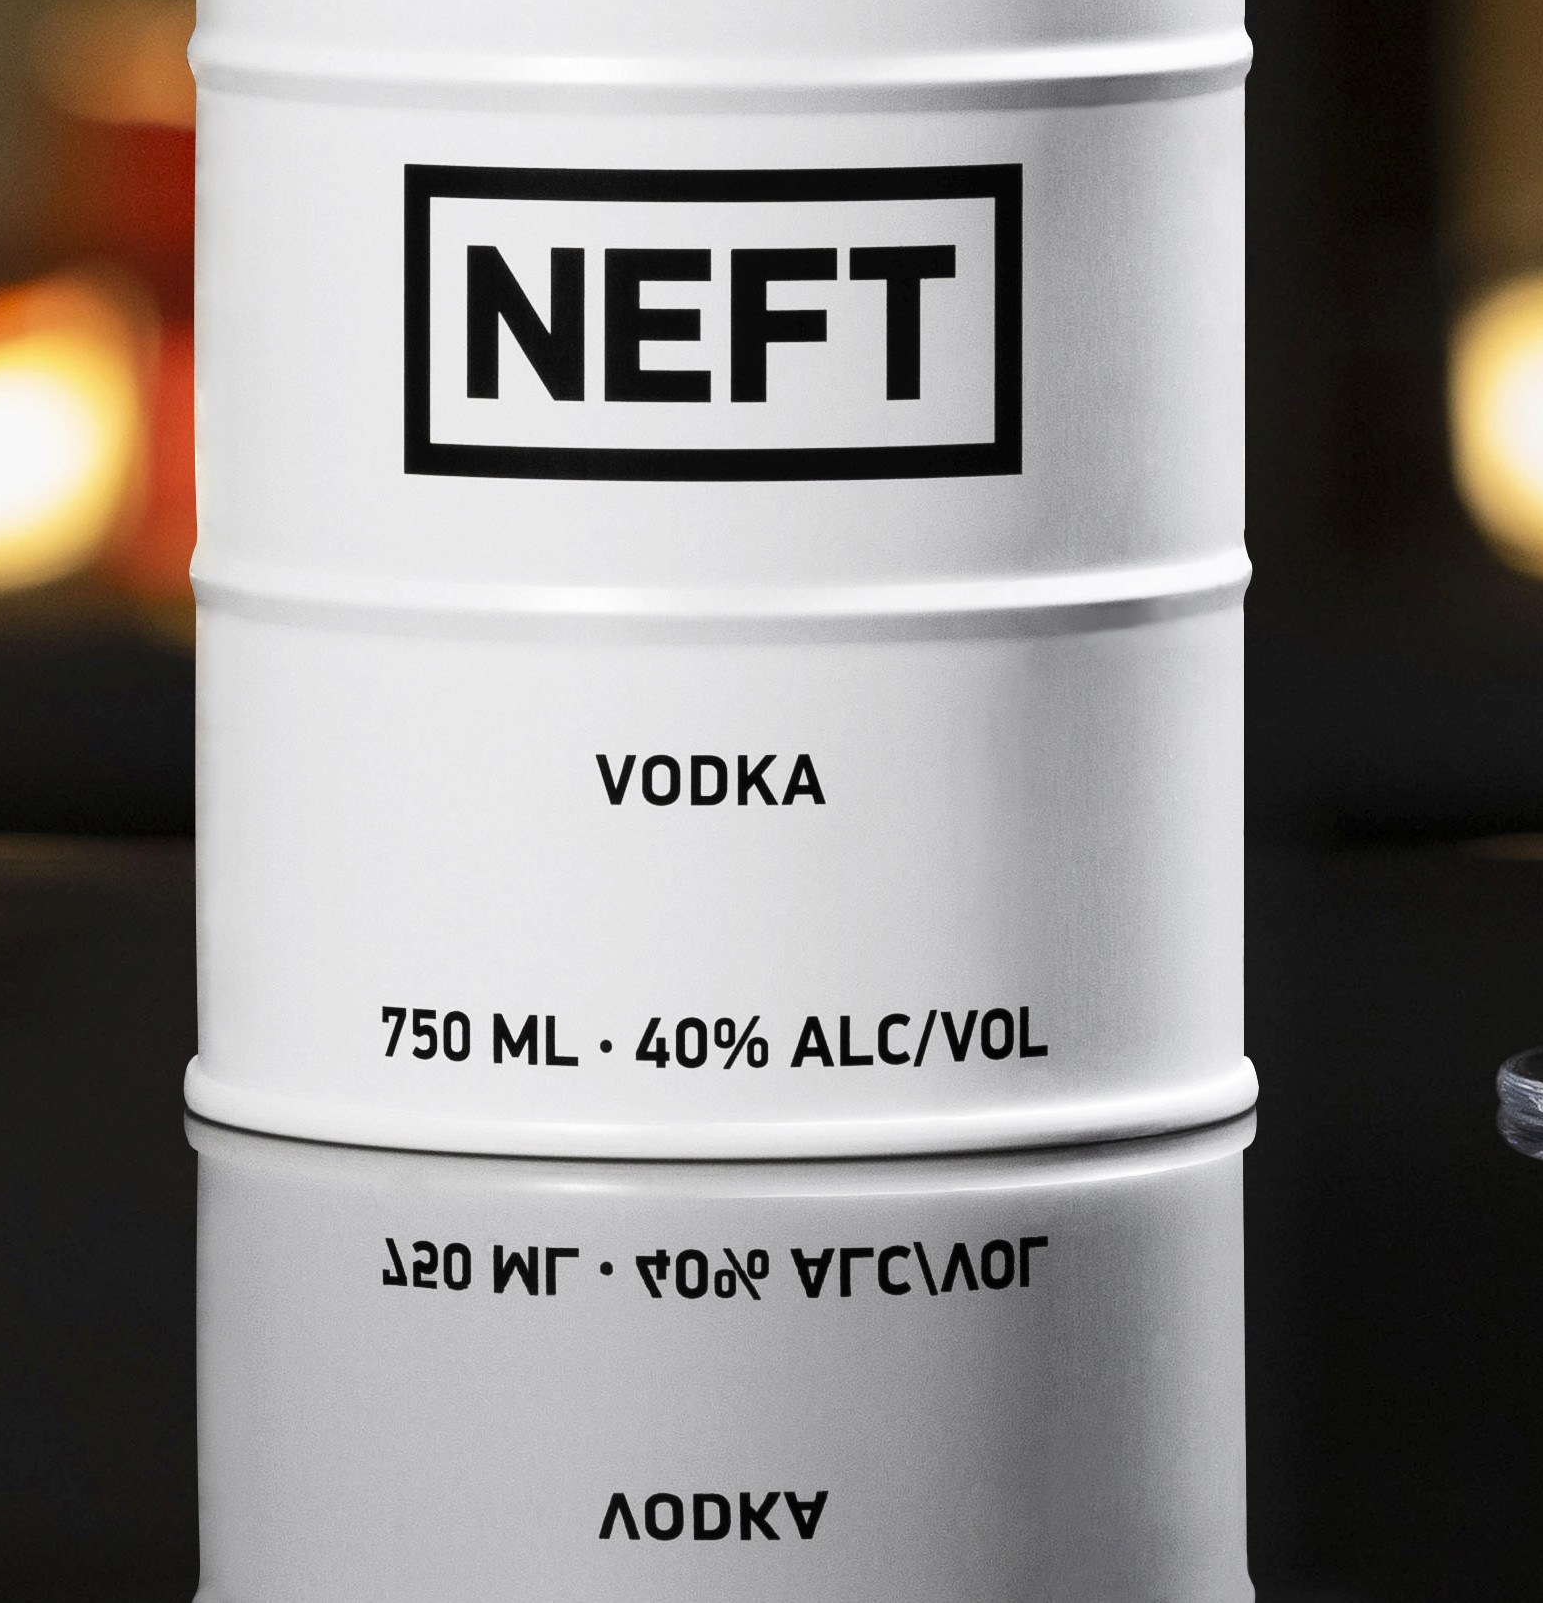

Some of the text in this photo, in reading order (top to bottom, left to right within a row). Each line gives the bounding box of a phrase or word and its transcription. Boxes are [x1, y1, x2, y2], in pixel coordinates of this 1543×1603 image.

[466, 244, 957, 403] NEFT
[595, 753, 826, 807] VODKA
[382, 1006, 471, 1062] 750
[493, 1013, 579, 1067] ML
[635, 1015, 769, 1070] 40%
[790, 1005, 1049, 1068] ALC/VOL
